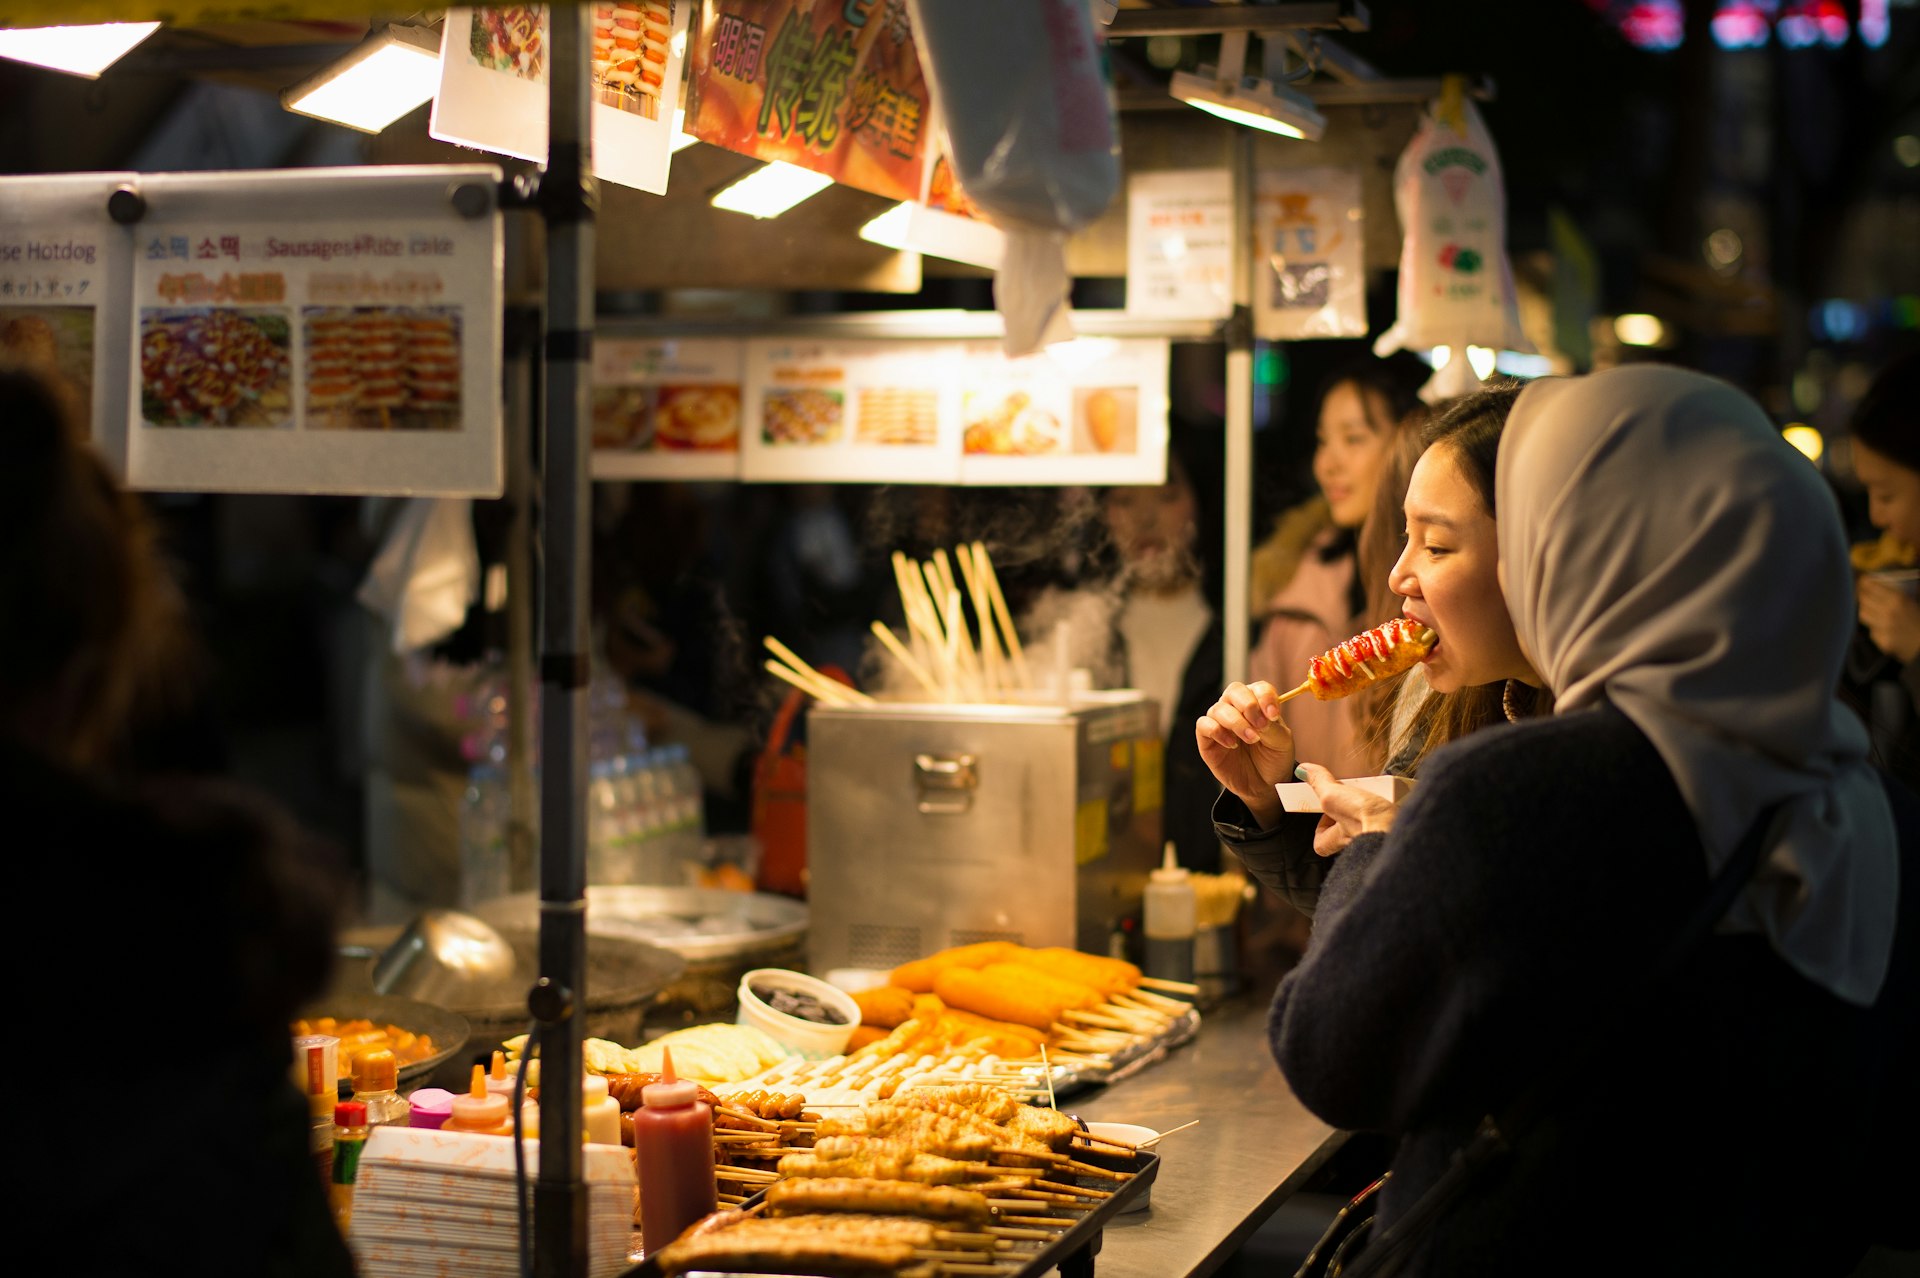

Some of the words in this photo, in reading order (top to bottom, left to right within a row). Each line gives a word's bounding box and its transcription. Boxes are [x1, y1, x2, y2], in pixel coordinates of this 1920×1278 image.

[713, 13, 767, 84] 明洞
[757, 5, 856, 150] 传统
[0, 240, 21, 261] se
[27, 238, 96, 264] Hotdog
[197, 235, 241, 263] 소떡
